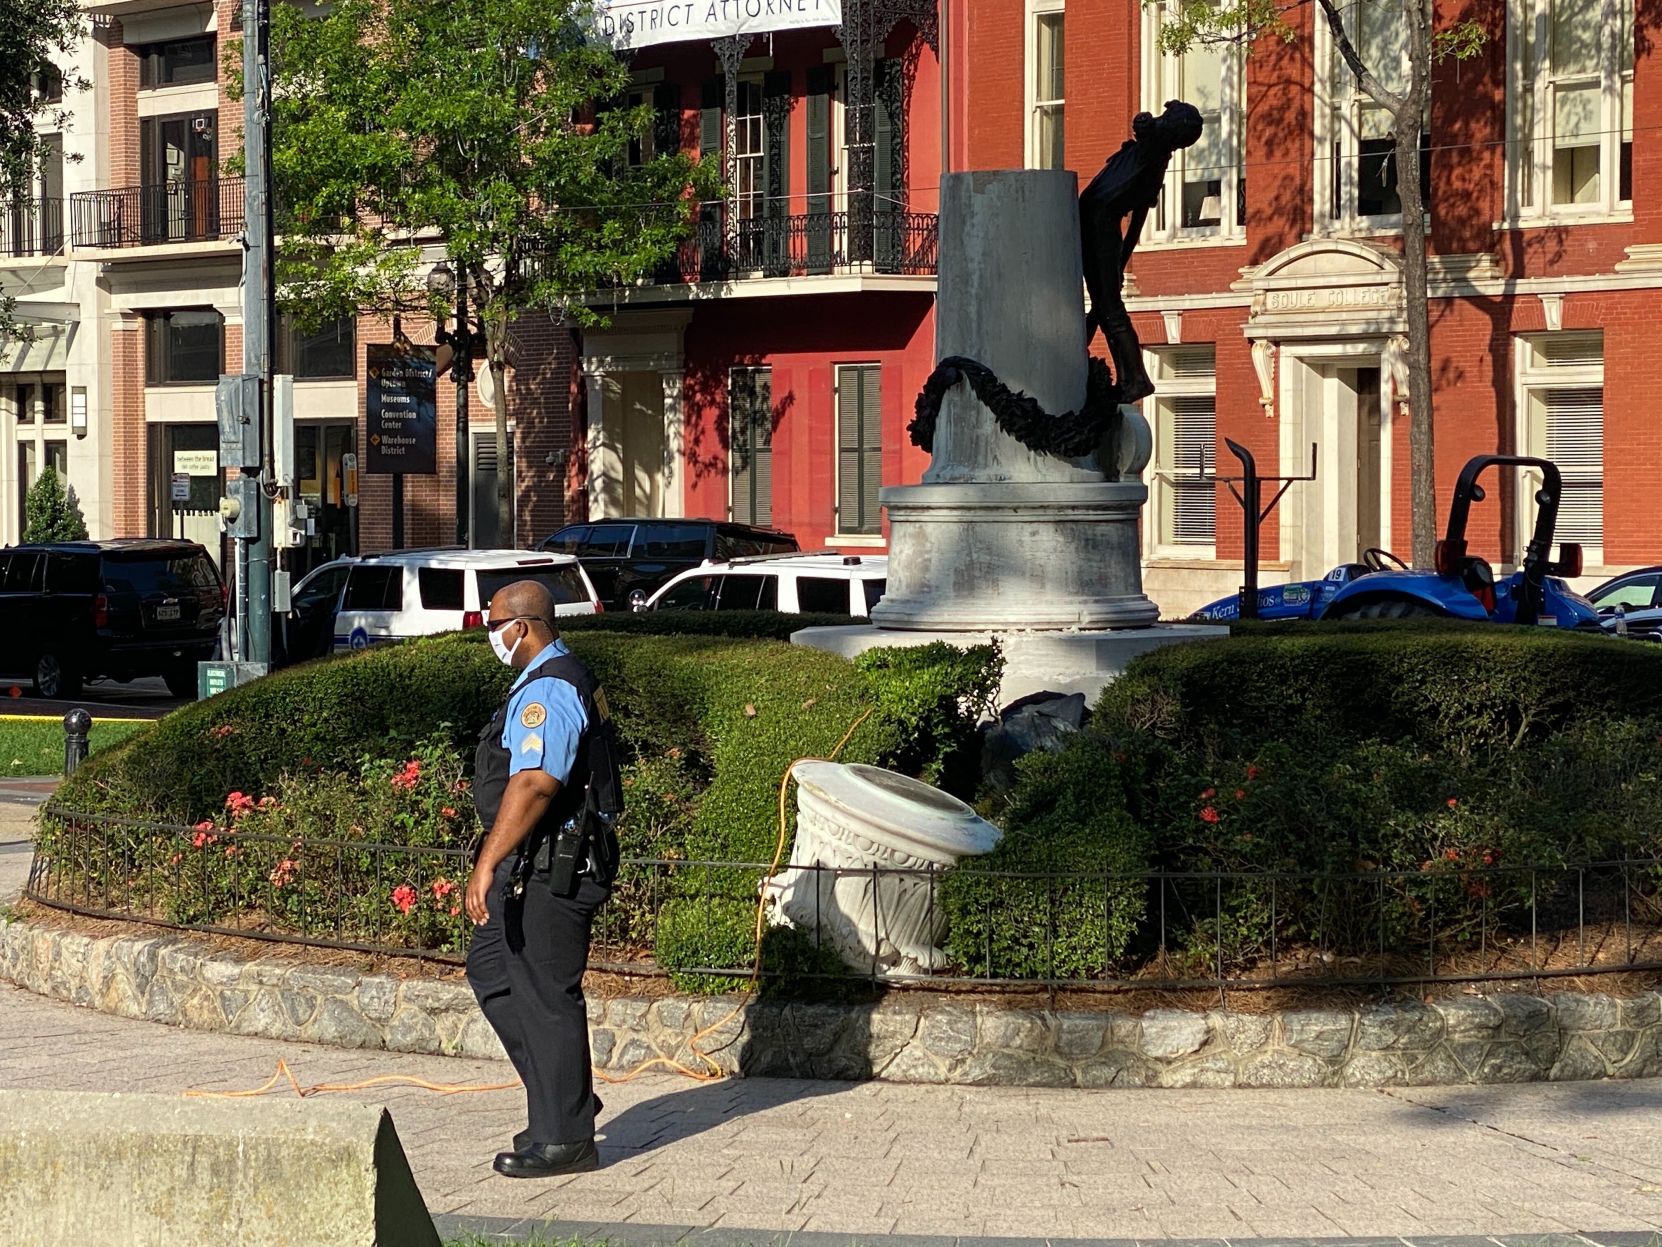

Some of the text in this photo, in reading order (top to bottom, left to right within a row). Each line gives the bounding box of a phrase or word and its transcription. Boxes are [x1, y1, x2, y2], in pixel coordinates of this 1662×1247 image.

[604, 3, 694, 37] DISTRICT
[1272, 288, 1388, 309] SOULE COLLEGE
[381, 368, 432, 378] Garden District/
[381, 379, 406, 389] Uptown
[381, 393, 411, 403] Museums
[381, 409, 417, 419] Convention
[381, 420, 402, 429] Center
[381, 435, 416, 445] Warehouse
[381, 445, 406, 455] District
[1332, 569, 1342, 580] 19
[1212, 604, 1235, 619] Kern
